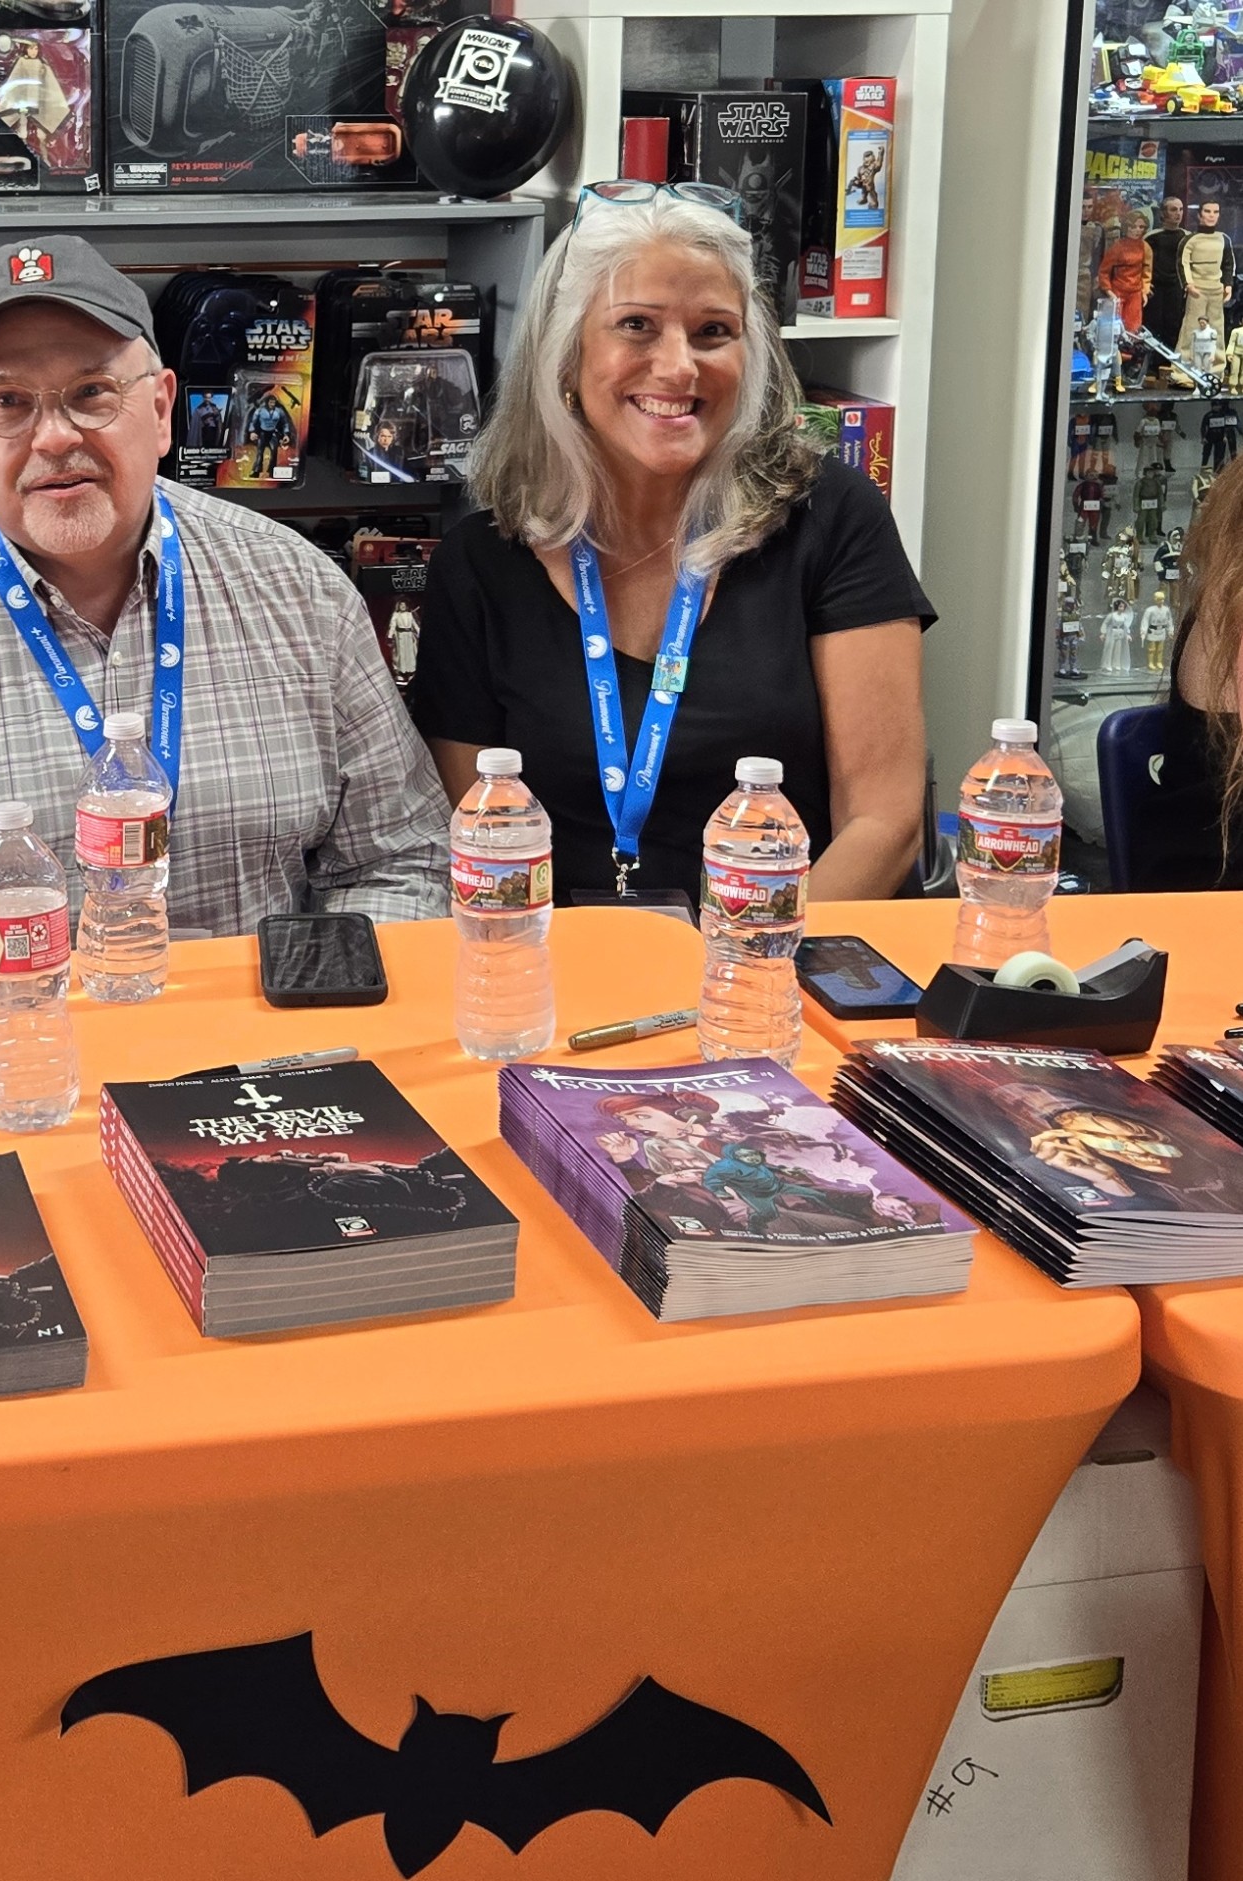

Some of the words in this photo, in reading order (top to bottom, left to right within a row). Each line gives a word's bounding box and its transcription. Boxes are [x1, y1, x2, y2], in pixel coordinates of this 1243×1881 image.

[466, 33, 488, 45] MAD
[487, 36, 513, 51] CAVE
[457, 47, 501, 81] 10
[855, 85, 884, 93] STAR
[856, 92, 884, 100] WARS
[718, 102, 790, 120] STAR
[718, 120, 790, 137] WARS
[245, 319, 311, 335] STAR
[245, 335, 311, 350] WARS
[978, 836, 1038, 852] ARROWHEAD
[711, 879, 766, 900] ARROWHEAD
[907, 1051, 991, 1063] SOUL
[989, 1054, 1100, 1071] TAKER
[558, 1079, 646, 1094] SOUL
[647, 1073, 762, 1093] TAKER
[189, 1115, 248, 1128] THE
[251, 1105, 354, 1123] DEVIL
[189, 1122, 259, 1137] THAT
[265, 1112, 365, 1130] WEARS
[214, 1131, 267, 1146] MY
[273, 1123, 354, 1140] FACE
[340, 1219, 370, 1234] 10
